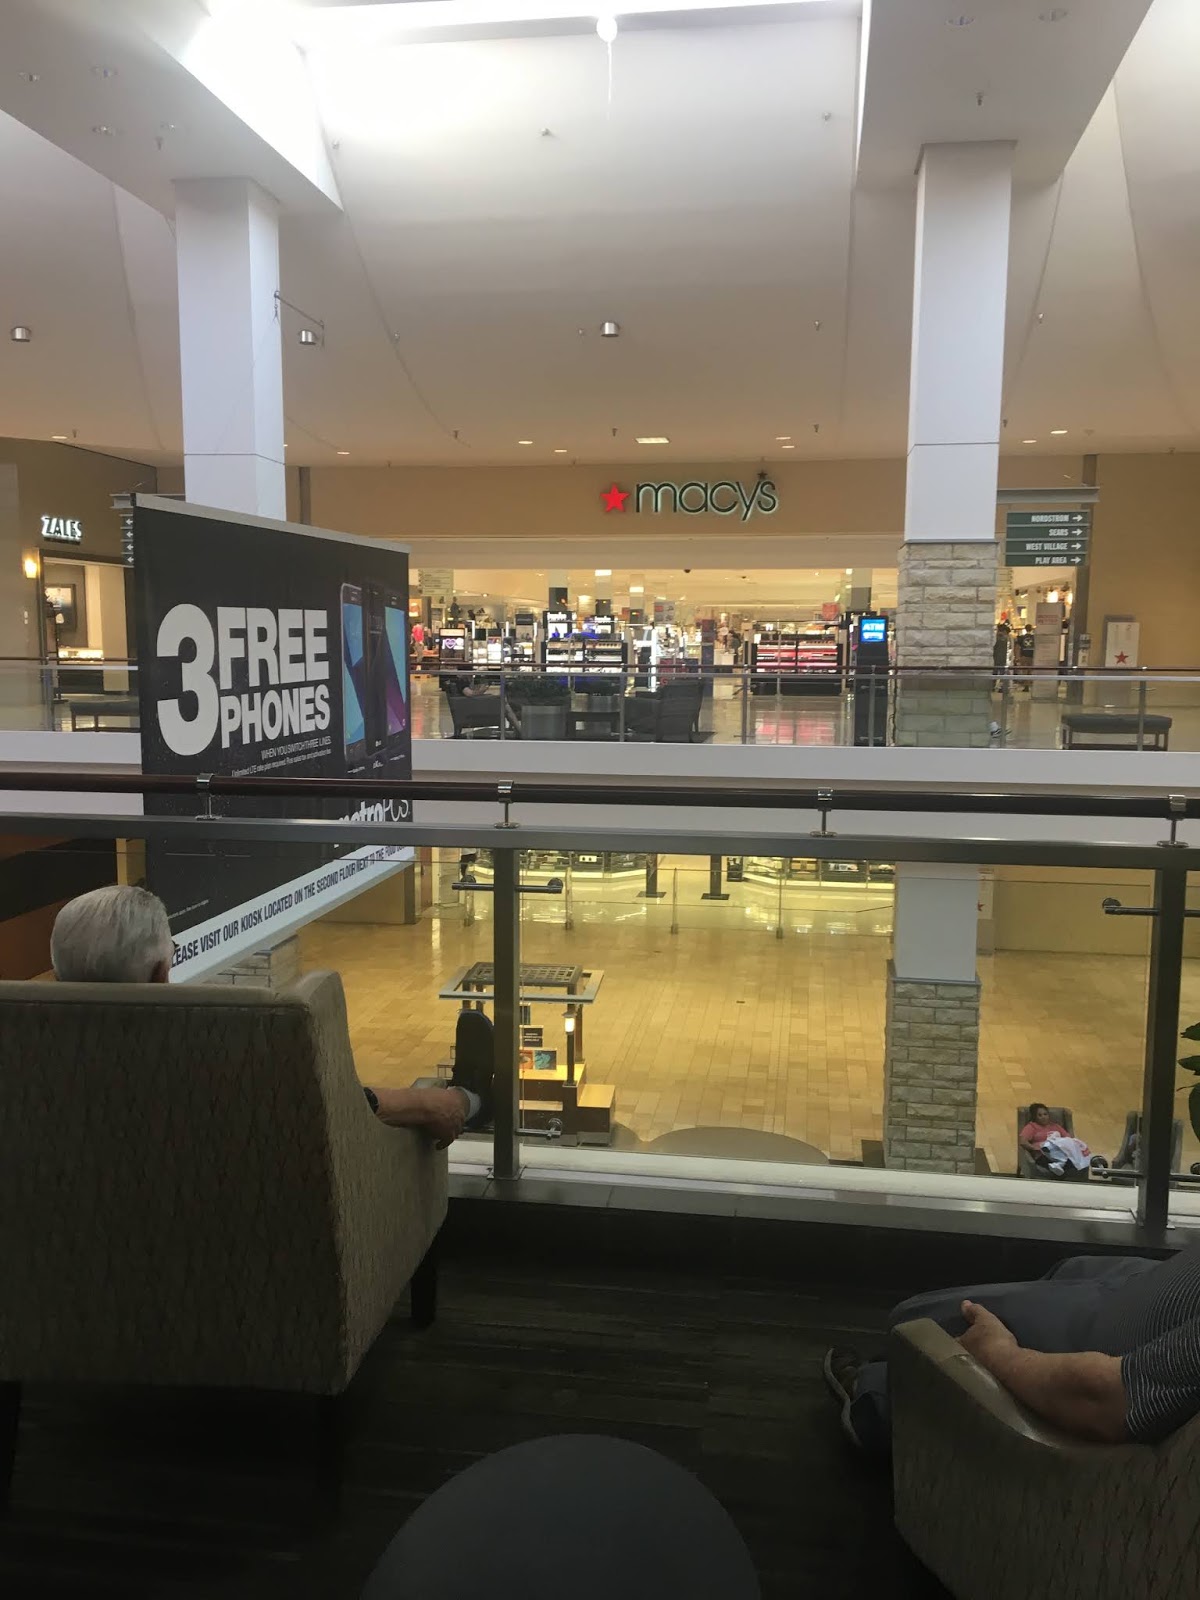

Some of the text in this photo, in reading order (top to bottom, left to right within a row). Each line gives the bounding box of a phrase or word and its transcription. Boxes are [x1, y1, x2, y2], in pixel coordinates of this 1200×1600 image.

[1031, 514, 1070, 522] NORDSTROM
[41, 516, 82, 540] ZALES
[1048, 528, 1069, 536] SEARS
[1026, 542, 1068, 550] WEST VILLAGE
[1035, 556, 1067, 565] PLAY AREA
[862, 622, 885, 631] ATM
[217, 606, 330, 690] FREE
[157, 603, 219, 756] 3
[220, 684, 331, 749] PHONES
[261, 748, 277, 760] WHEN
[276, 745, 288, 756] YOU
[338, 799, 410, 822] troPCS
[171, 938, 199, 968] LEASE
[200, 928, 221, 953] VISIT
[223, 920, 239, 941] OUR
[241, 908, 263, 932] KIOSK
[264, 893, 293, 920] LOCATED
[294, 888, 303, 904] ON
[304, 882, 316, 899] THE
[316, 871, 339, 894] SECOND
[339, 863, 356, 881] FLOOR
[355, 856, 369, 872] NEXT
[369, 853, 375, 864] TO
[375, 847, 384, 860] THE
